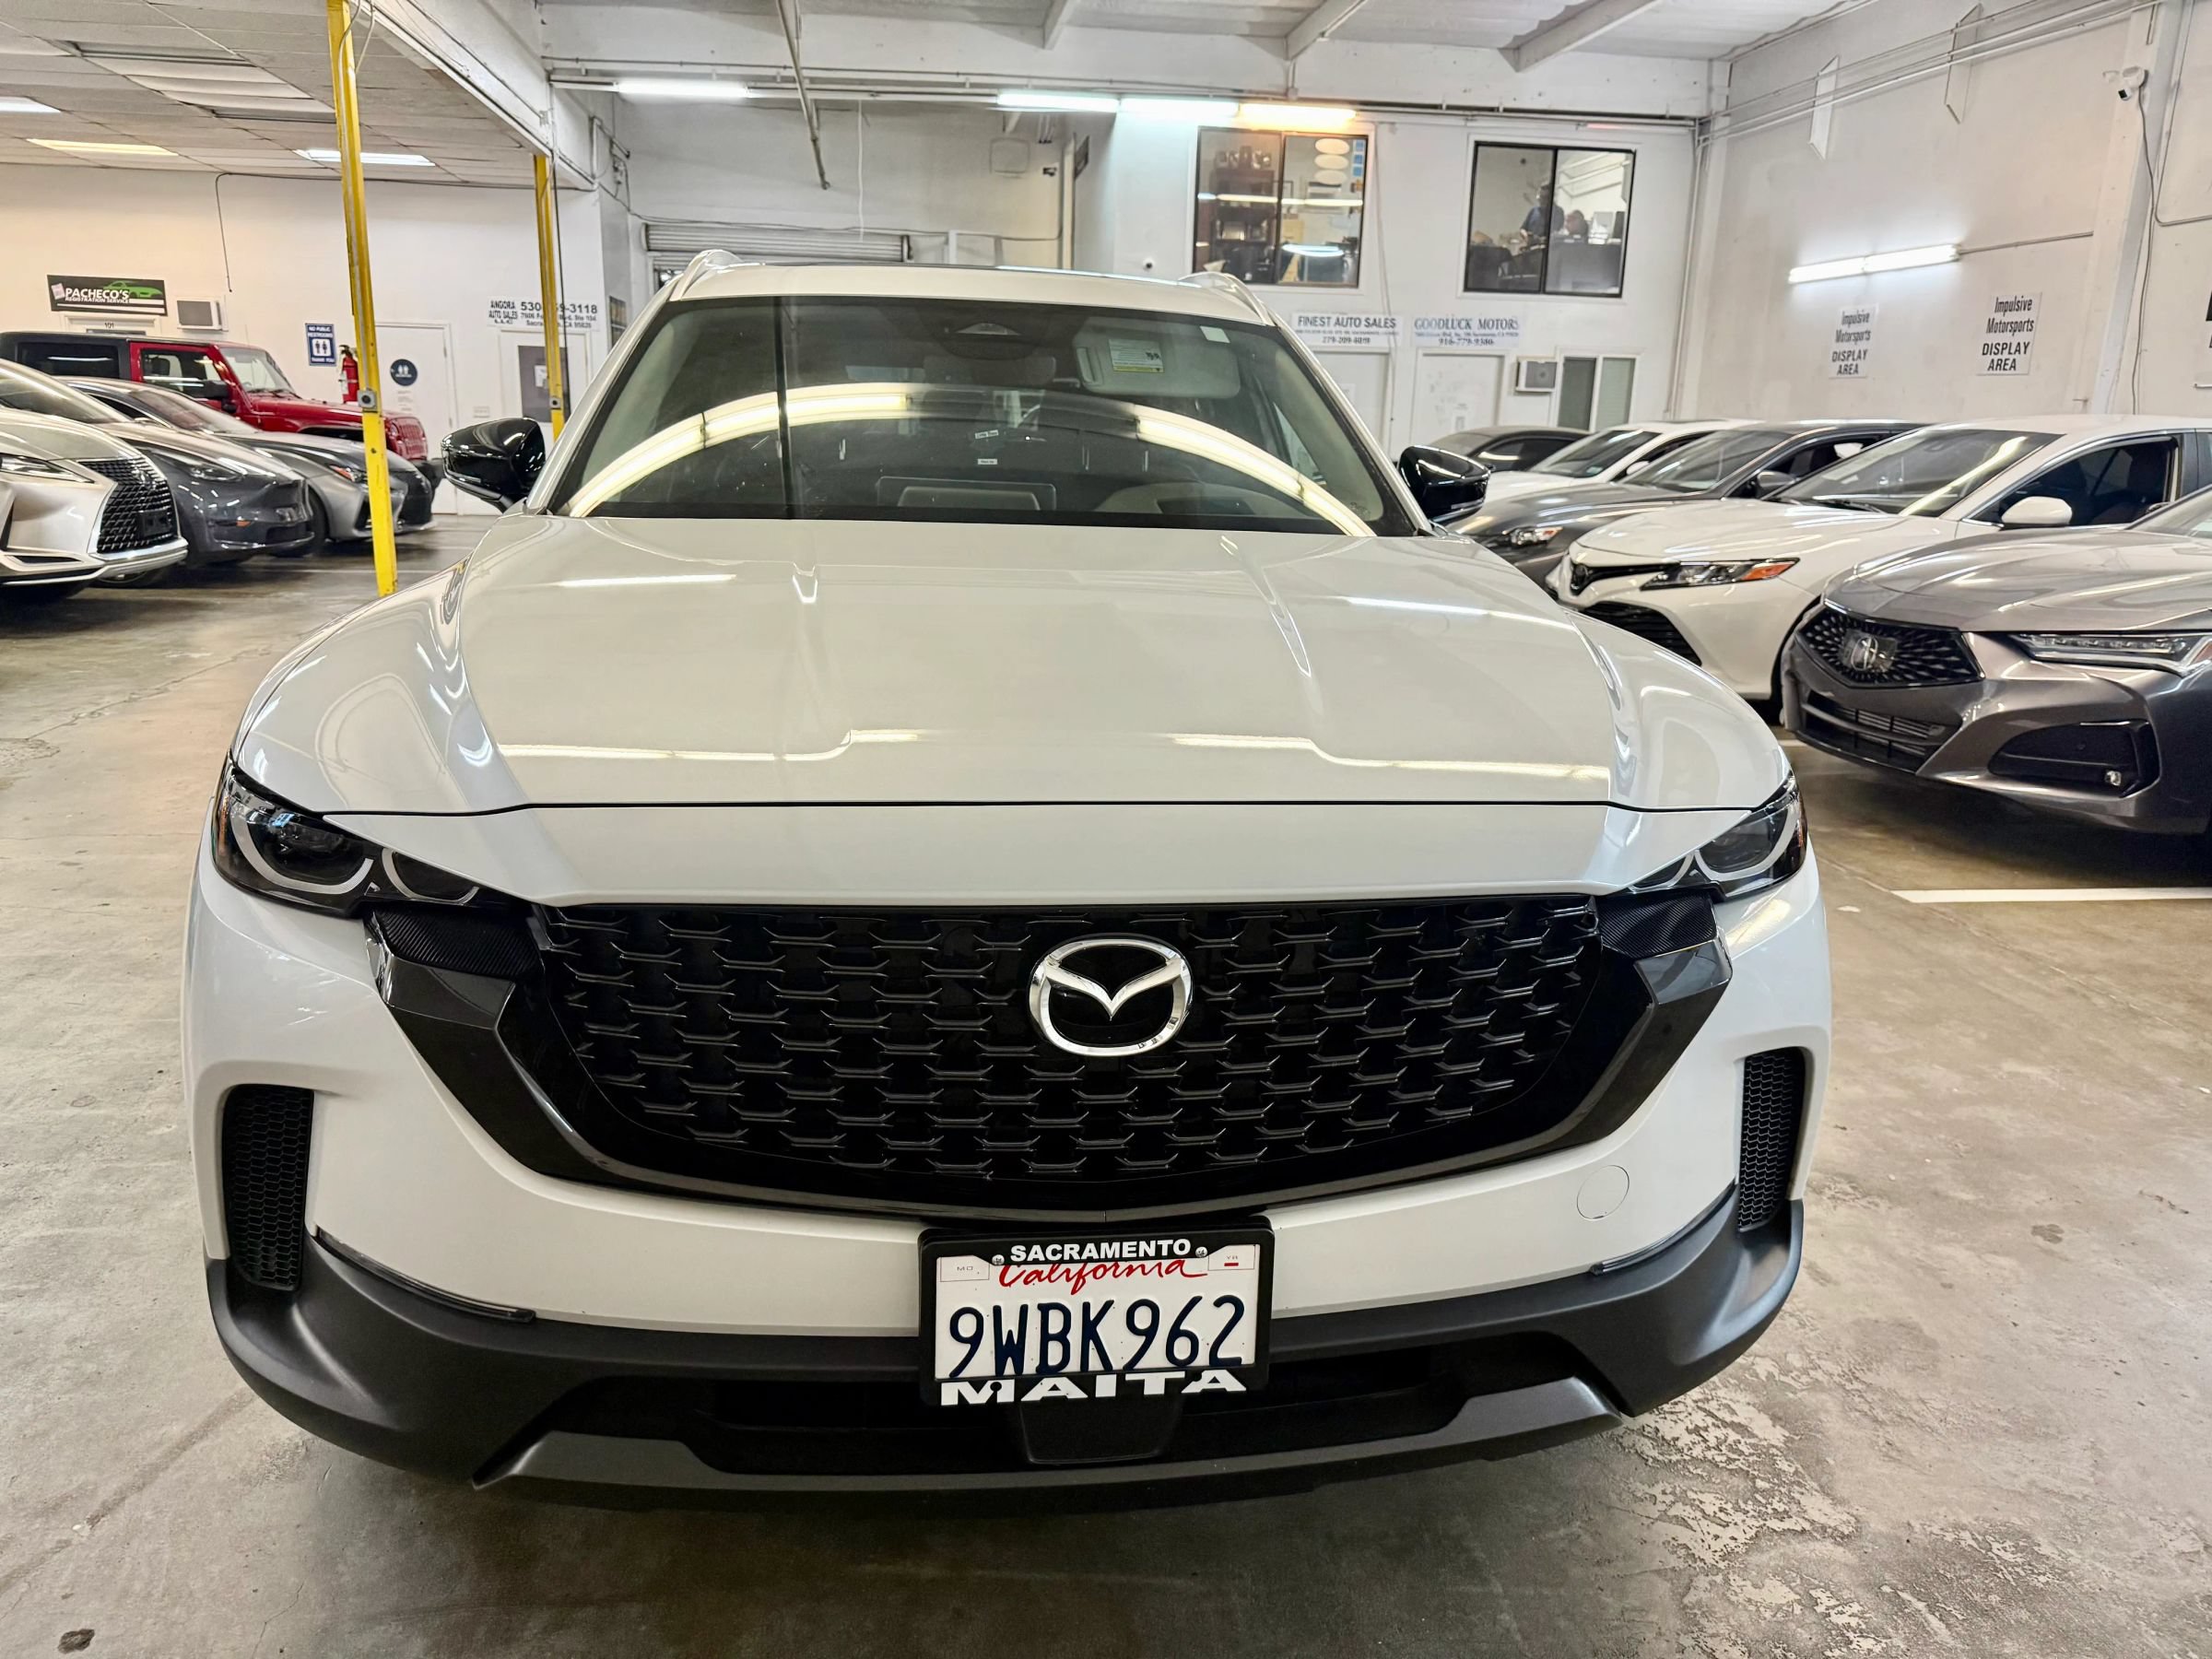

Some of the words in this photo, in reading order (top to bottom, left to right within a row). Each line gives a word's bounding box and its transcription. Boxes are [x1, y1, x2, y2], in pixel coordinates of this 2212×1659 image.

[65, 288, 129, 300] PACHECO'S
[1994, 295, 2032, 317] Impulsive
[1298, 316, 1332, 327] FINEST
[1334, 316, 1362, 328] AUTO
[1363, 317, 1397, 329] SALES
[1414, 317, 1473, 330] GOODLUCK
[1841, 309, 1870, 328] Impulsive
[1985, 317, 2034, 336] Motorsports
[1835, 329, 1871, 345] Motorsports
[1831, 349, 1867, 362] DISPLAY
[1982, 341, 2030, 356] DISPLAY
[1837, 363, 1859, 375] AREA
[1987, 358, 2017, 371] AREA
[1010, 1238, 1192, 1263] SACRAMENTO
[998, 1258, 1208, 1295] California
[948, 1294, 1245, 1378] 9WBK962
[940, 1369, 1247, 1406] MAITA
